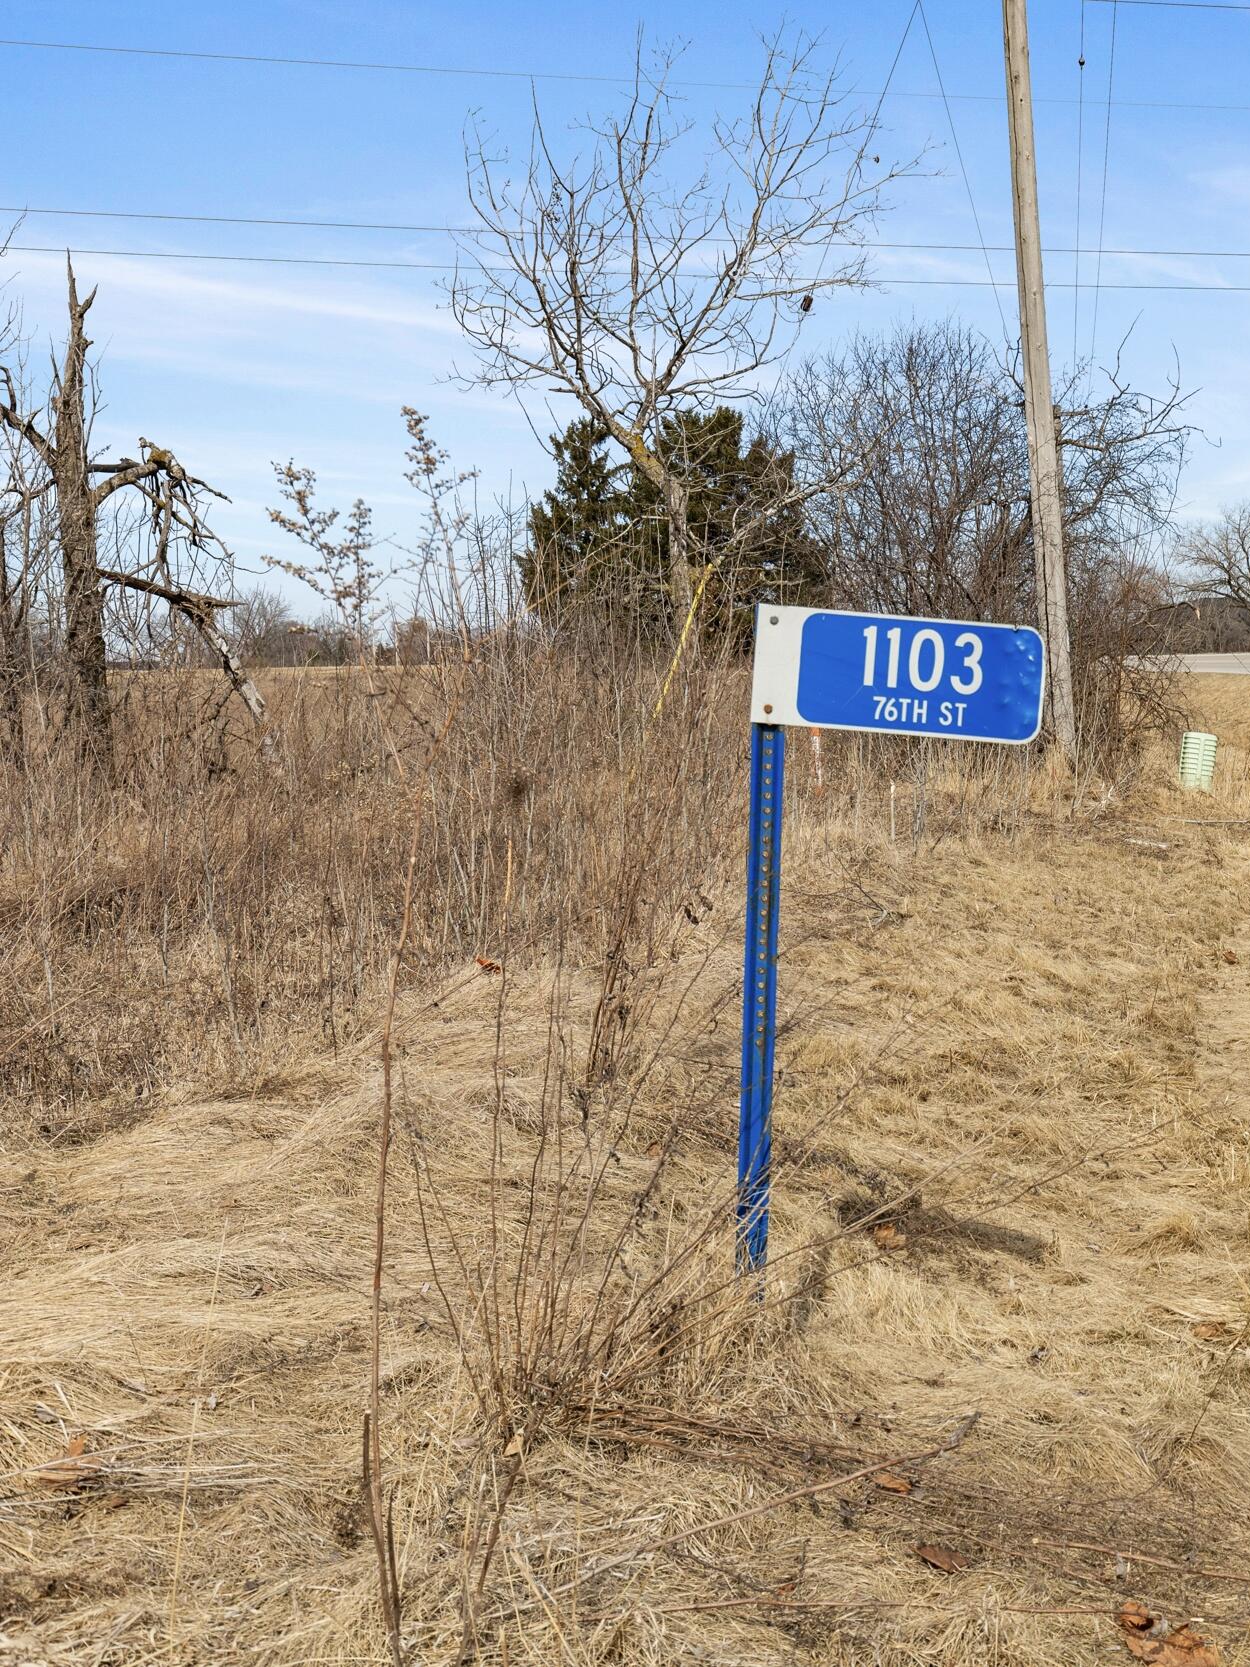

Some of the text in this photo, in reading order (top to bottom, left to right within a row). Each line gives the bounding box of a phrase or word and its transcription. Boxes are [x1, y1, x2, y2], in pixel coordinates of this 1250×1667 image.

[862, 625, 983, 695] 1103
[872, 696, 967, 727] 76TH ST
